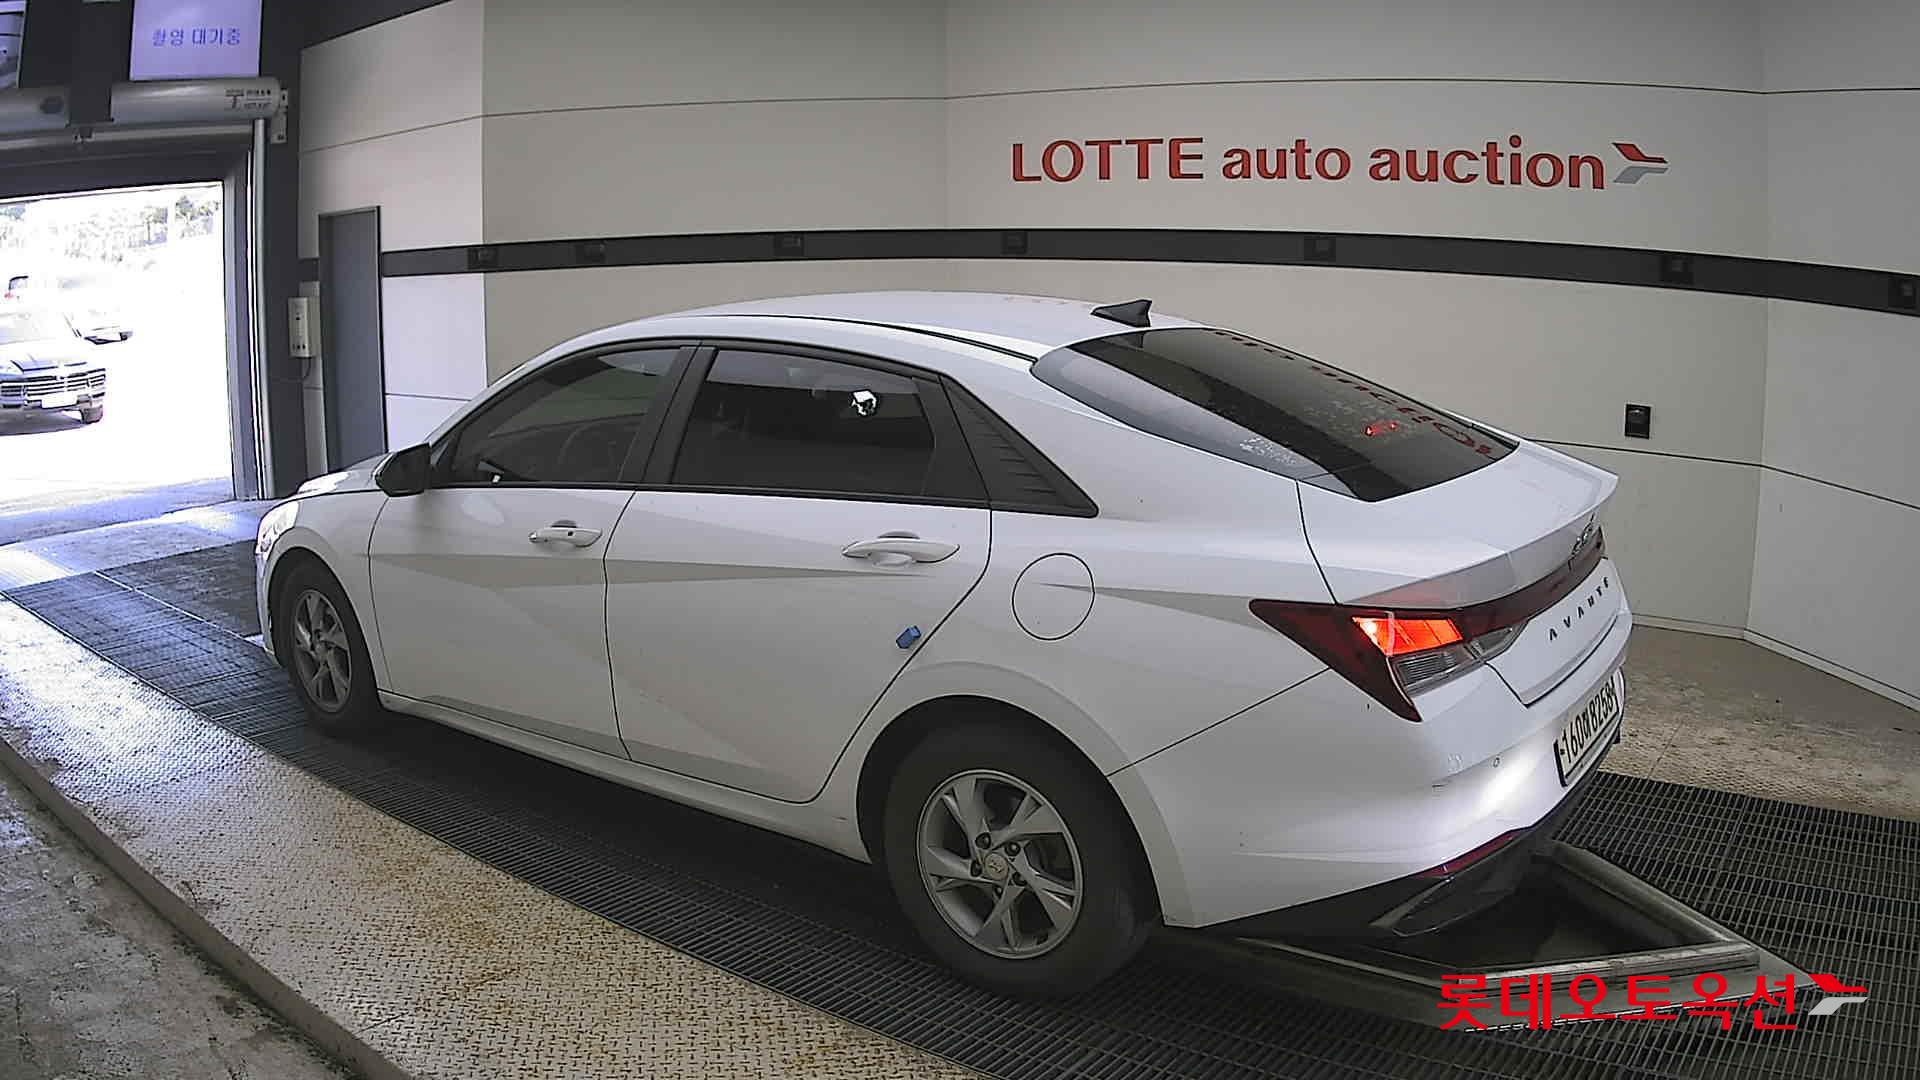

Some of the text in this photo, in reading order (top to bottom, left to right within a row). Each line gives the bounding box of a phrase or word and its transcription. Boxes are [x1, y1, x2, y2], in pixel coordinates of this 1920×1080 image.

[152, 27, 241, 47] 촬영 대기중
[1011, 135, 1606, 189] LOTTE auto auction
[1549, 576, 1609, 642] AVANTE
